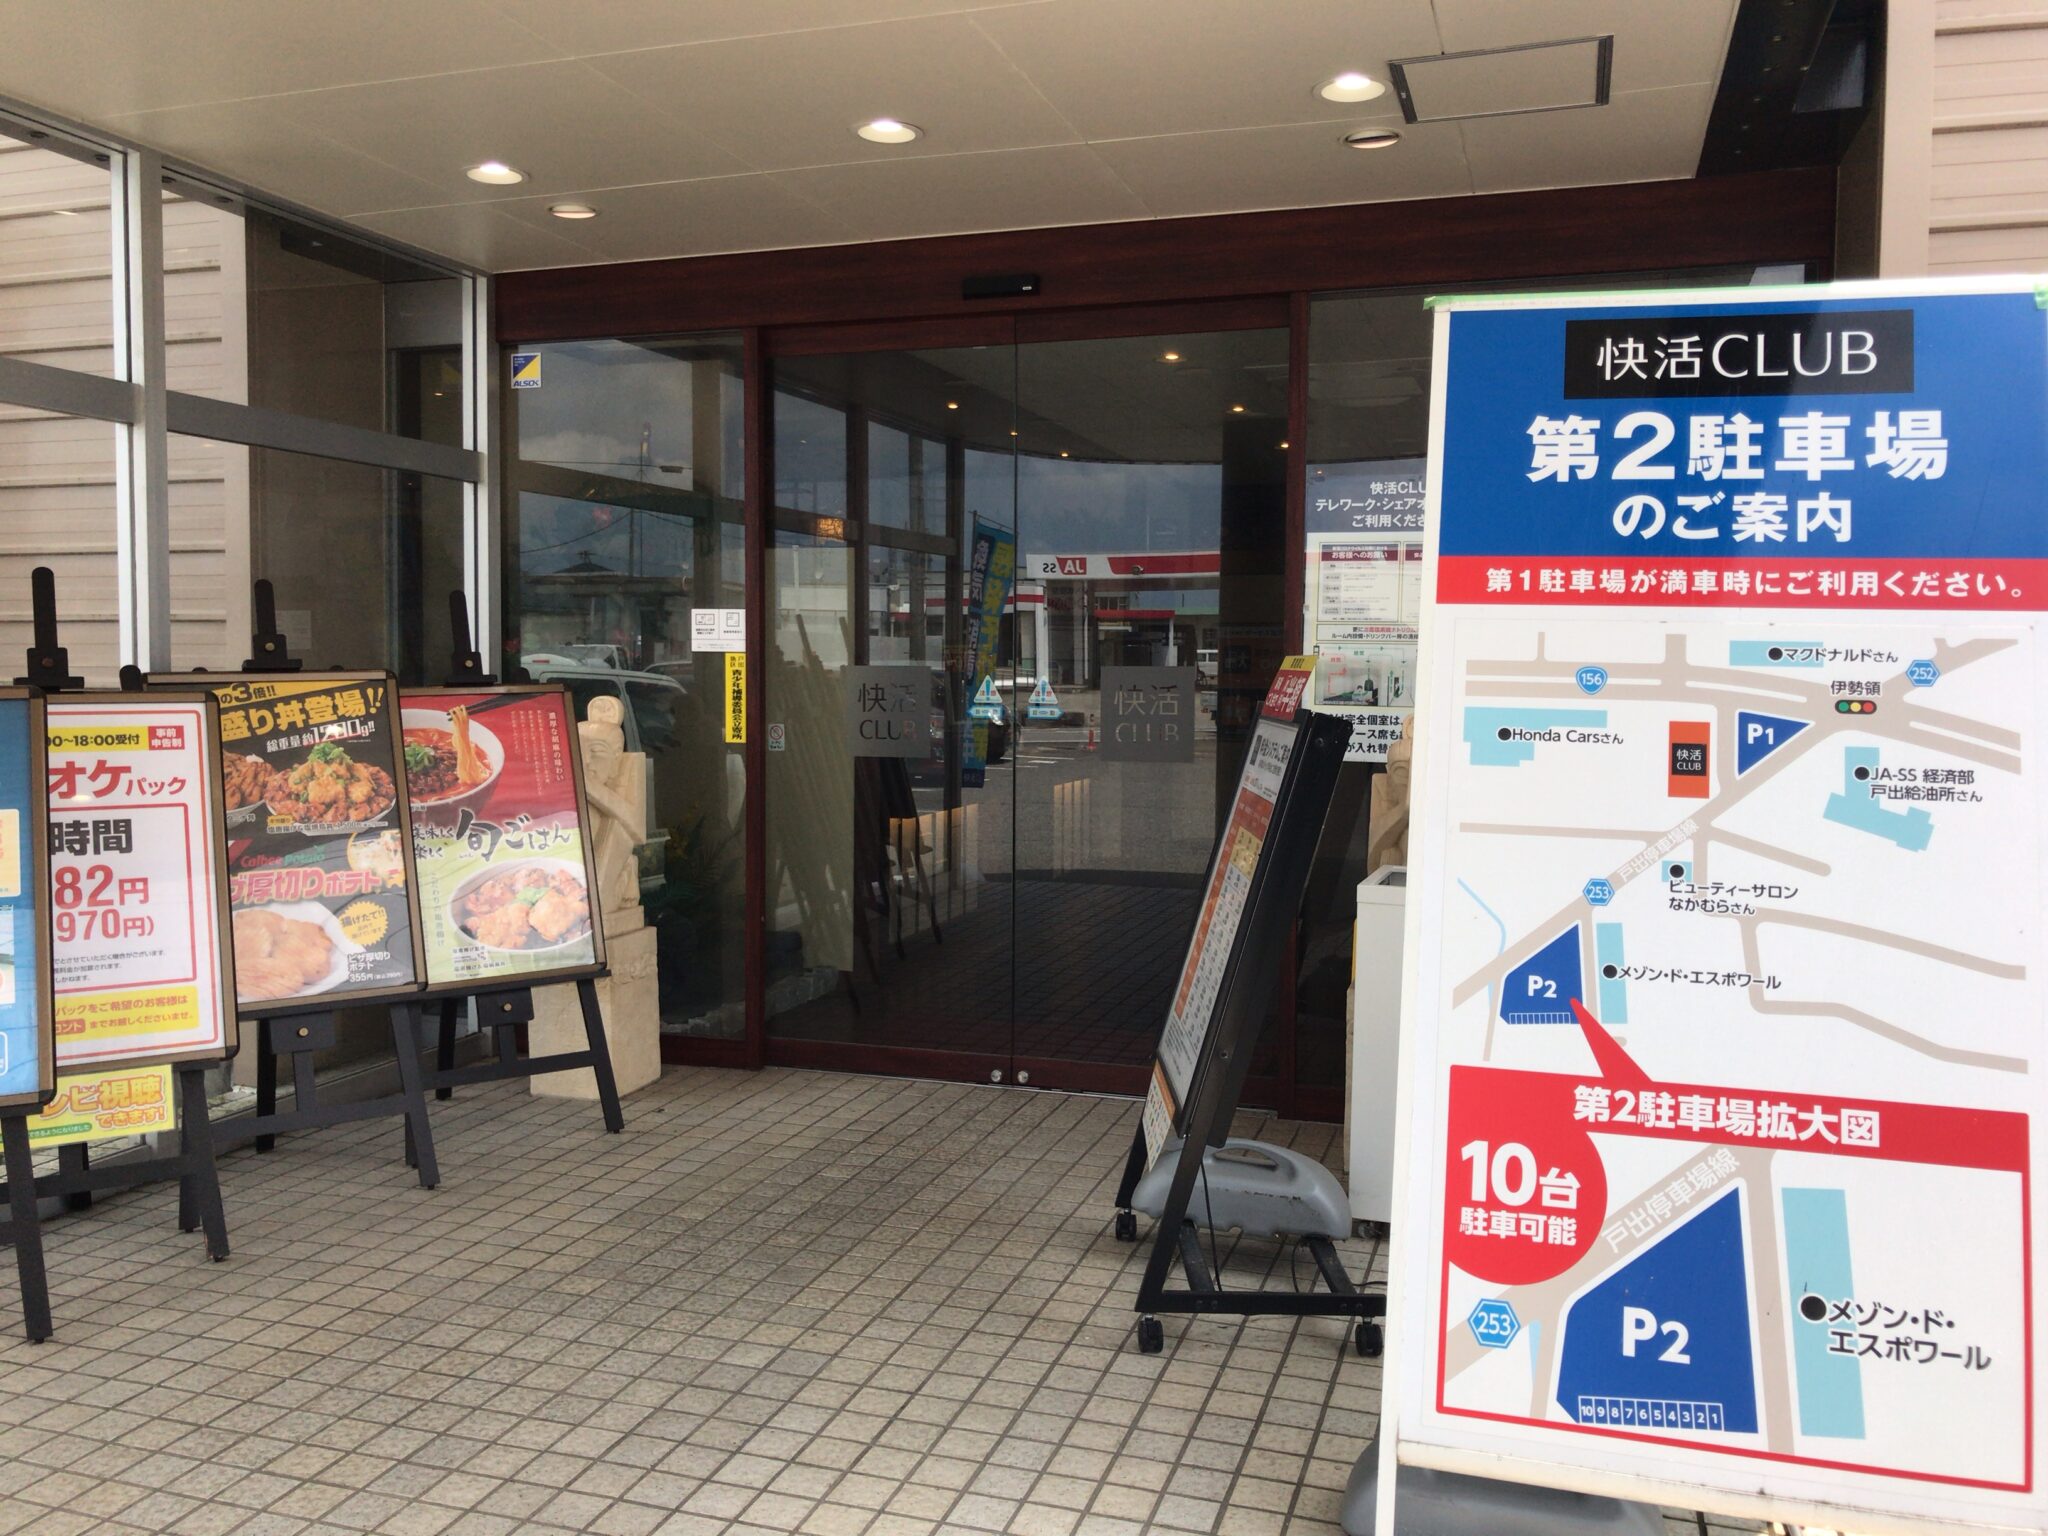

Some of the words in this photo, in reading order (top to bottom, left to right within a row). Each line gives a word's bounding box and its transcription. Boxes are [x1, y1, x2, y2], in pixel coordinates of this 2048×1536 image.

[1596, 331, 1879, 380] 快活CLUB
[1525, 410, 1950, 483] 第2駐車場
[1612, 491, 1852, 544] のご案内
[1485, 567, 2024, 599] 第1駐車場が満車時にご利用ください。
[1785, 646, 1899, 664] マクドナルドさん
[1580, 672, 1603, 687] 156
[1912, 666, 1935, 681] 252
[1114, 684, 1180, 716] 快活
[1830, 680, 1881, 697] 伊勢領
[1512, 727, 1562, 743] Honda
[1566, 729, 1624, 745] Carsさん
[1747, 724, 1775, 745] P1
[1676, 748, 1702, 762] 快活
[1676, 761, 1702, 771] CLUB
[1870, 767, 1917, 782] JA-SS
[1922, 768, 1975, 786] 経済部
[1870, 785, 1983, 804] 戸出給油所さん
[50, 818, 133, 856] 時間
[54, 864, 150, 909] 82円
[1587, 885, 1610, 900] 253
[1668, 879, 1799, 900] ビューティーサロン
[1668, 897, 1756, 916] なかむらさん
[1527, 975, 1557, 998] P2
[1618, 964, 1782, 991] メゾン・ド・エスポワール
[1573, 1084, 1880, 1148] 第2駐車場拡大図
[1459, 1139, 1581, 1210] 10台
[1601, 1147, 1741, 1254] 戸出停車場線
[1458, 1206, 1577, 1247] 駐車可能
[1477, 1309, 1511, 1337] 253
[1828, 1299, 1956, 1333] メゾン・ド・
[1622, 1305, 1691, 1364] P2
[1828, 1331, 1992, 1372] エスポワール
[1581, 1406, 1593, 1416] 10
[1597, 1407, 1605, 1417] 9
[1611, 1408, 1619, 1417] 8
[1625, 1409, 1633, 1418] 7
[1640, 1409, 1647, 1419] 6
[1654, 1410, 1661, 1420] 5
[1668, 1411, 1676, 1421] 4
[1682, 1412, 1690, 1422] 3
[1697, 1413, 1705, 1423] 2
[1712, 1414, 1718, 1424] 1
